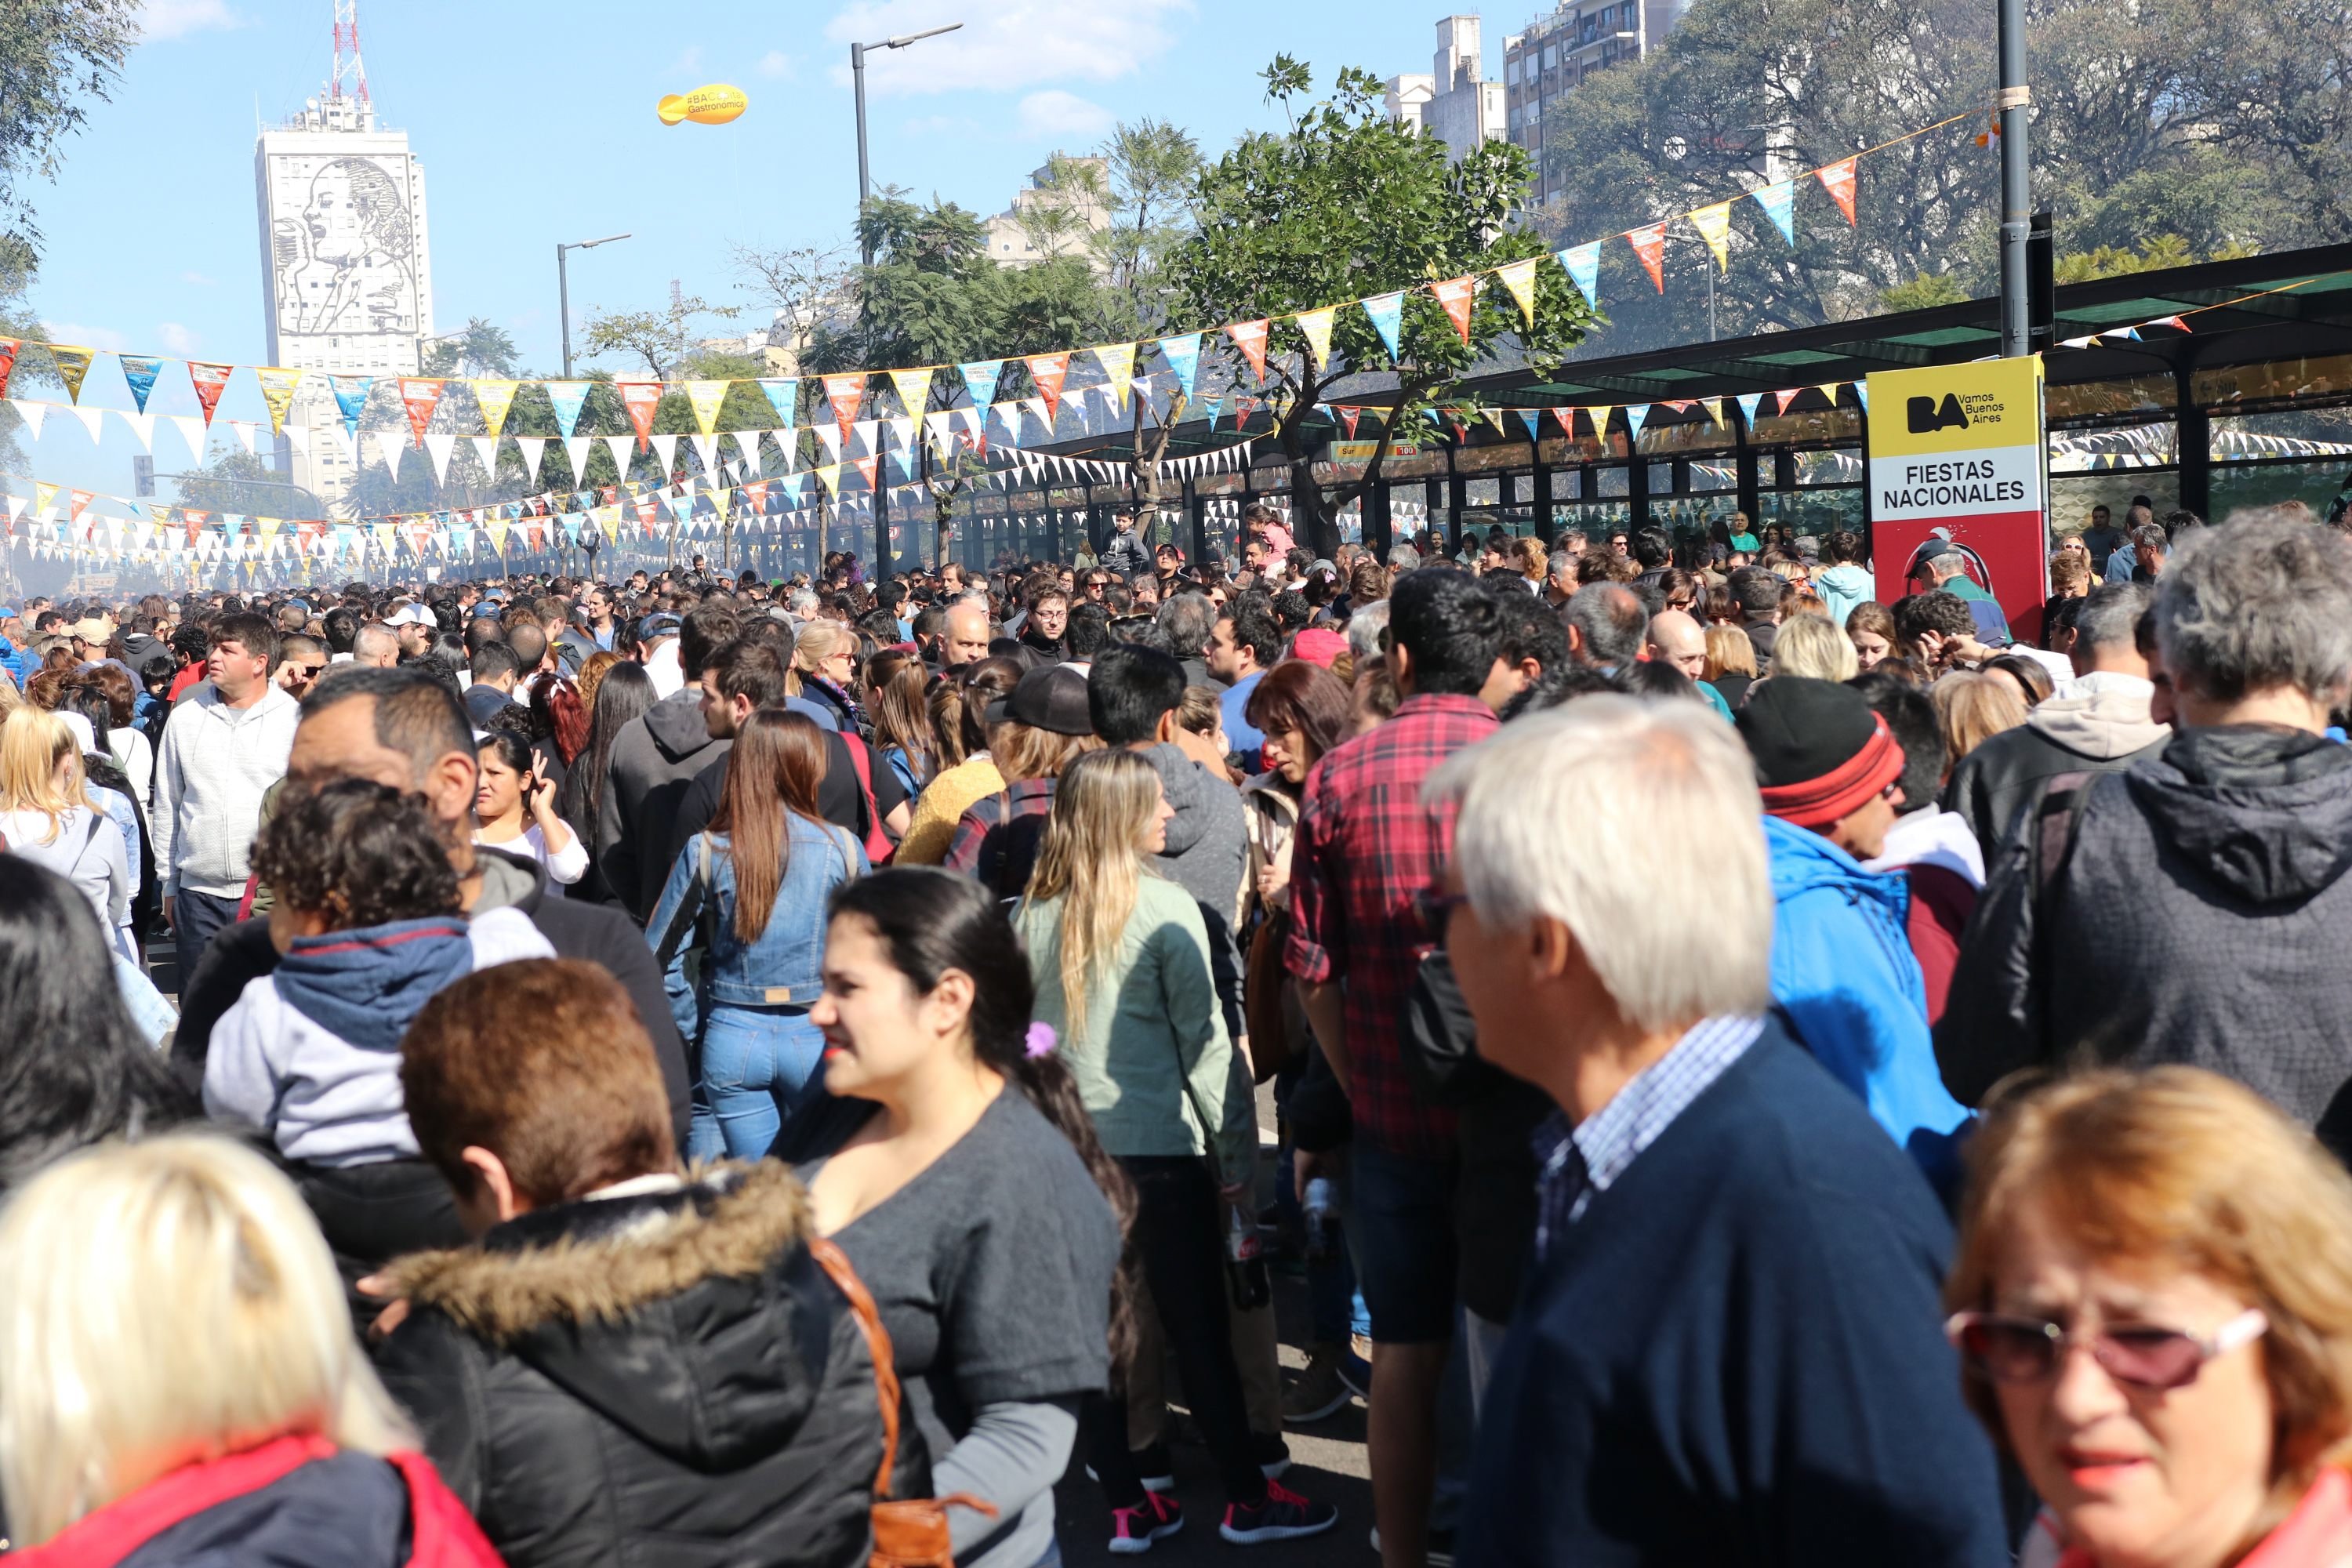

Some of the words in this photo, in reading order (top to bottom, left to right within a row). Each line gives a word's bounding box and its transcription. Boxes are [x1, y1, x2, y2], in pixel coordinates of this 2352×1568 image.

[1958, 394, 1994, 404] Vamos
[1907, 393, 1969, 434] BA
[1965, 403, 2005, 414] Buenos
[1973, 414, 2001, 424] Aires
[1906, 459, 1994, 485] FIESTAS
[1884, 481, 2024, 509] NACIONALES
